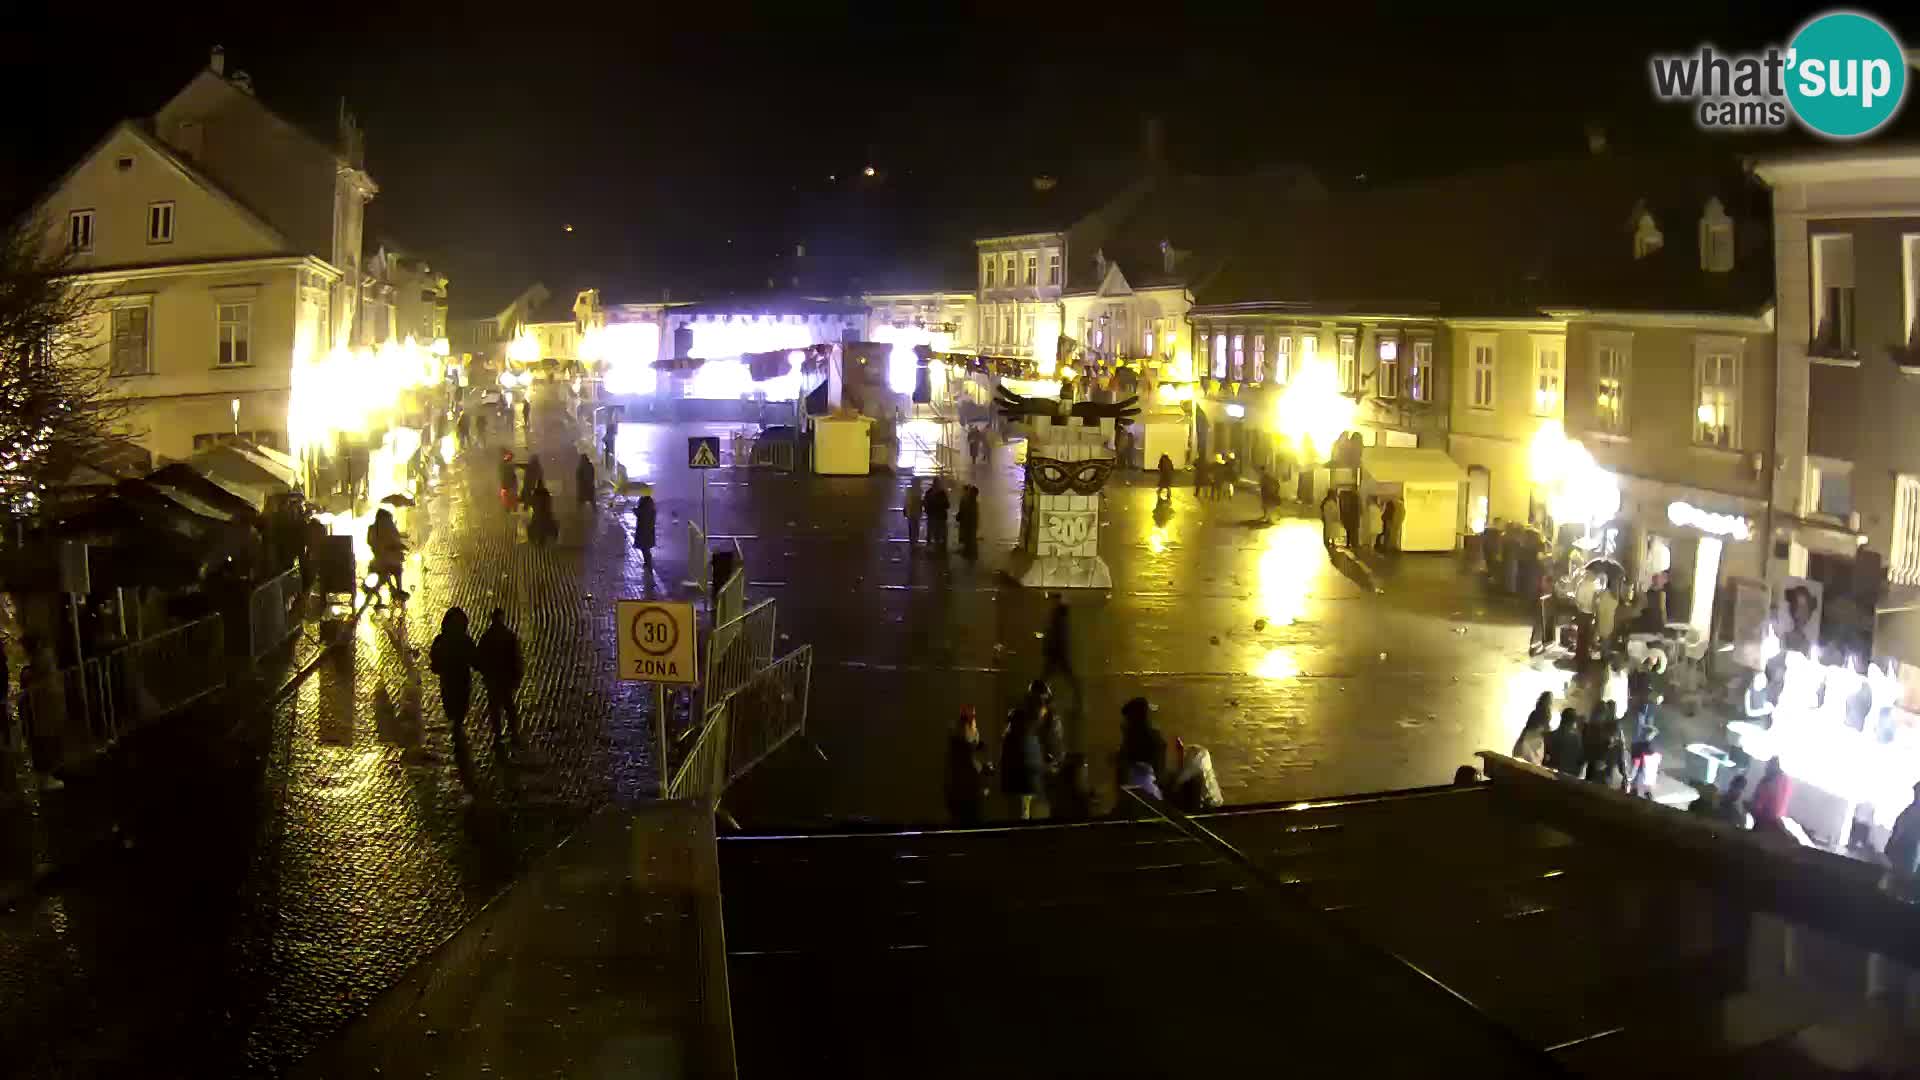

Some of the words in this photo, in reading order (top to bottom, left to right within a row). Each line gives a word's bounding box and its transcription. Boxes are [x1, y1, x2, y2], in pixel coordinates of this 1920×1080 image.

[1048, 516, 1088, 546] 200
[644, 622, 667, 643] 30
[633, 659, 679, 676] ZONA
